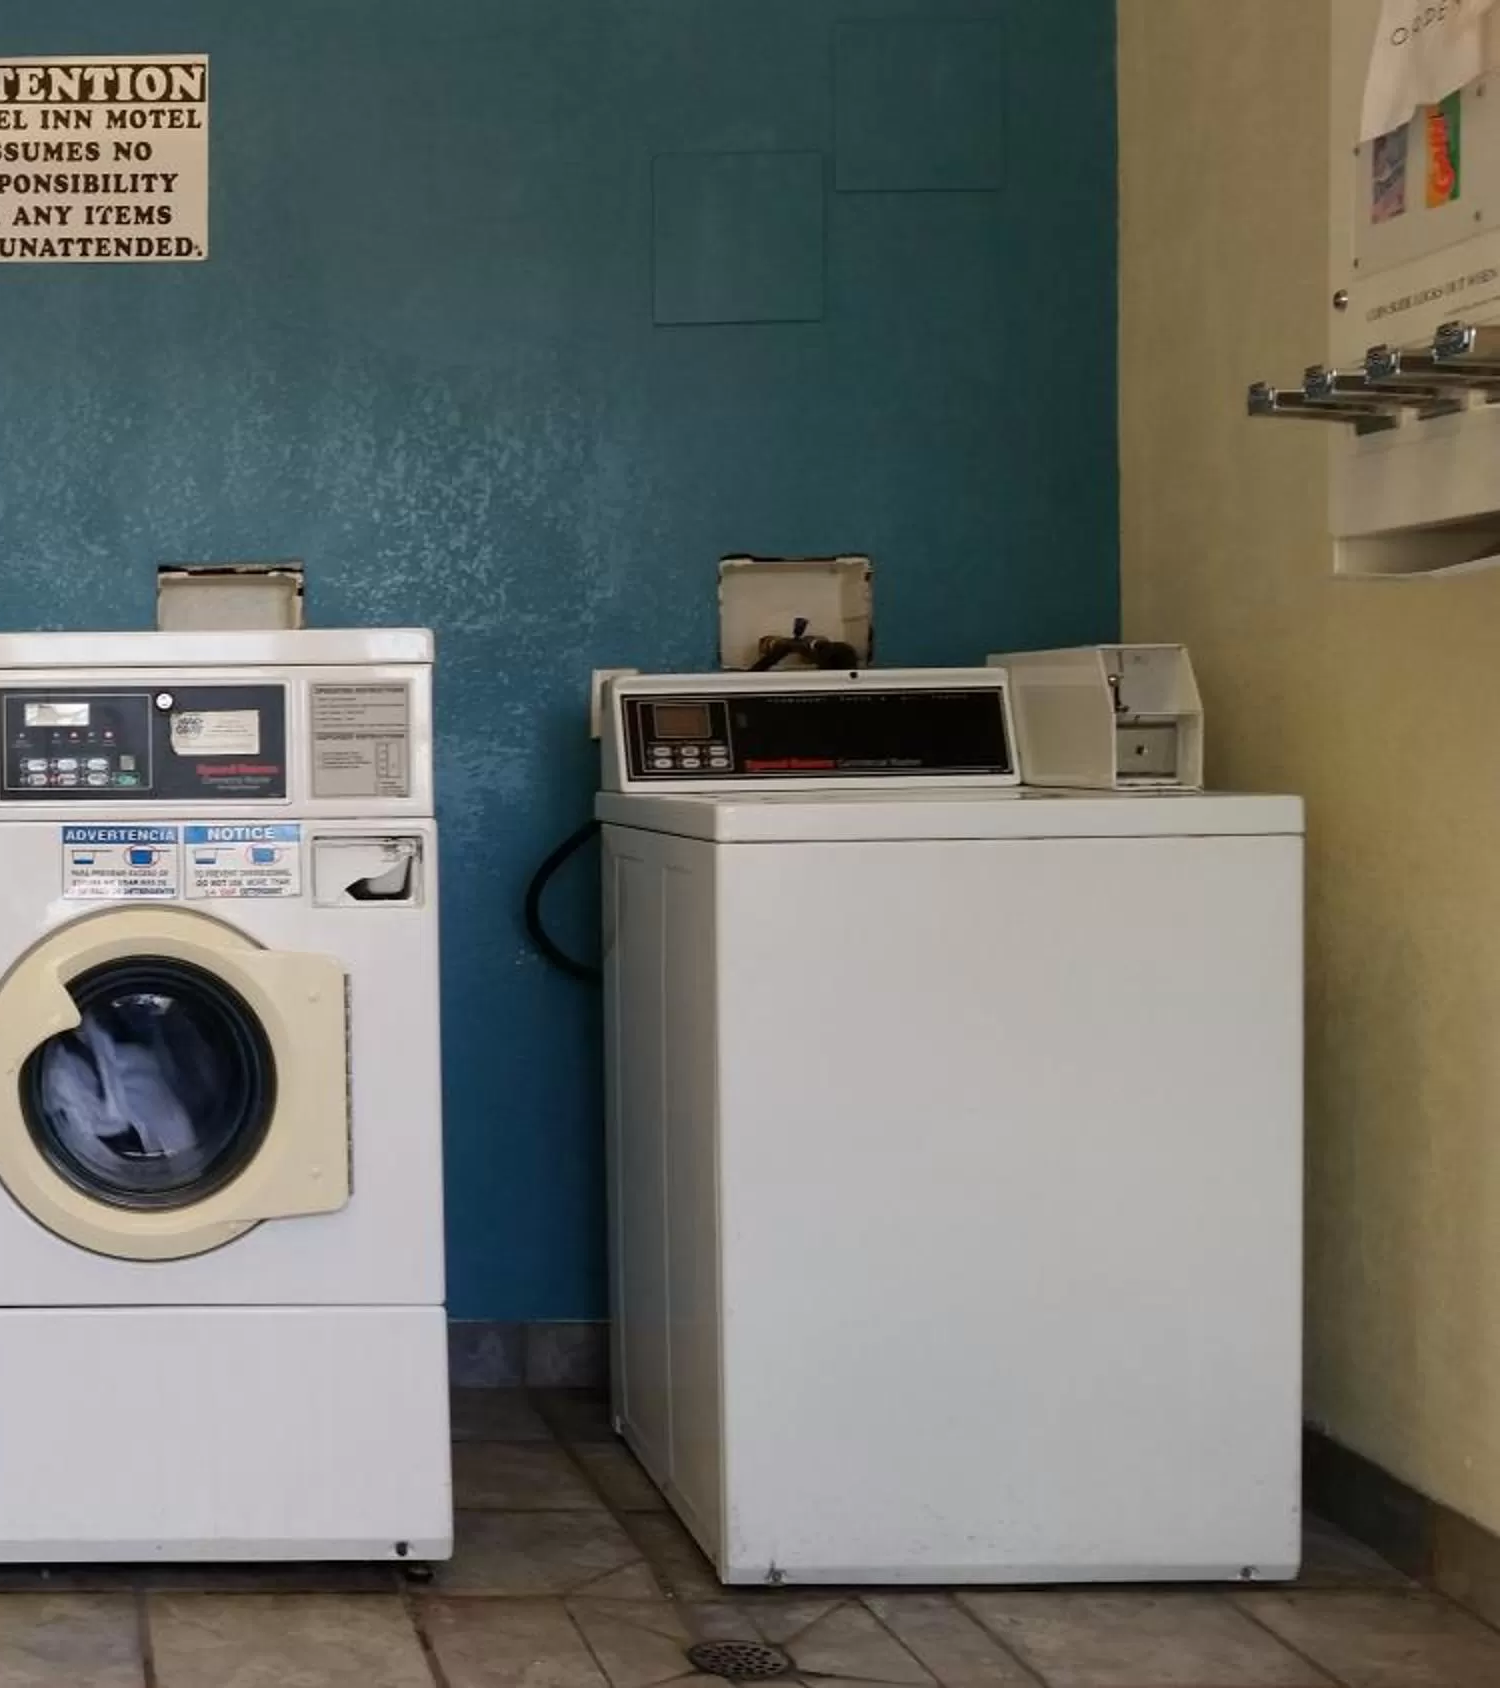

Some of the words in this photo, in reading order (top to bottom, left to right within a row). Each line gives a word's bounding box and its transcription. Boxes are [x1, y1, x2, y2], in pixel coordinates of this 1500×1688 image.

[39, 109, 92, 129] INN
[106, 109, 201, 129] MOTEL
[113, 141, 153, 161] NO
[12, 206, 73, 226] ANY
[85, 205, 172, 225] ITEMS
[65, 829, 175, 841] ADVERTENCIA
[207, 827, 275, 840] NOTICE
